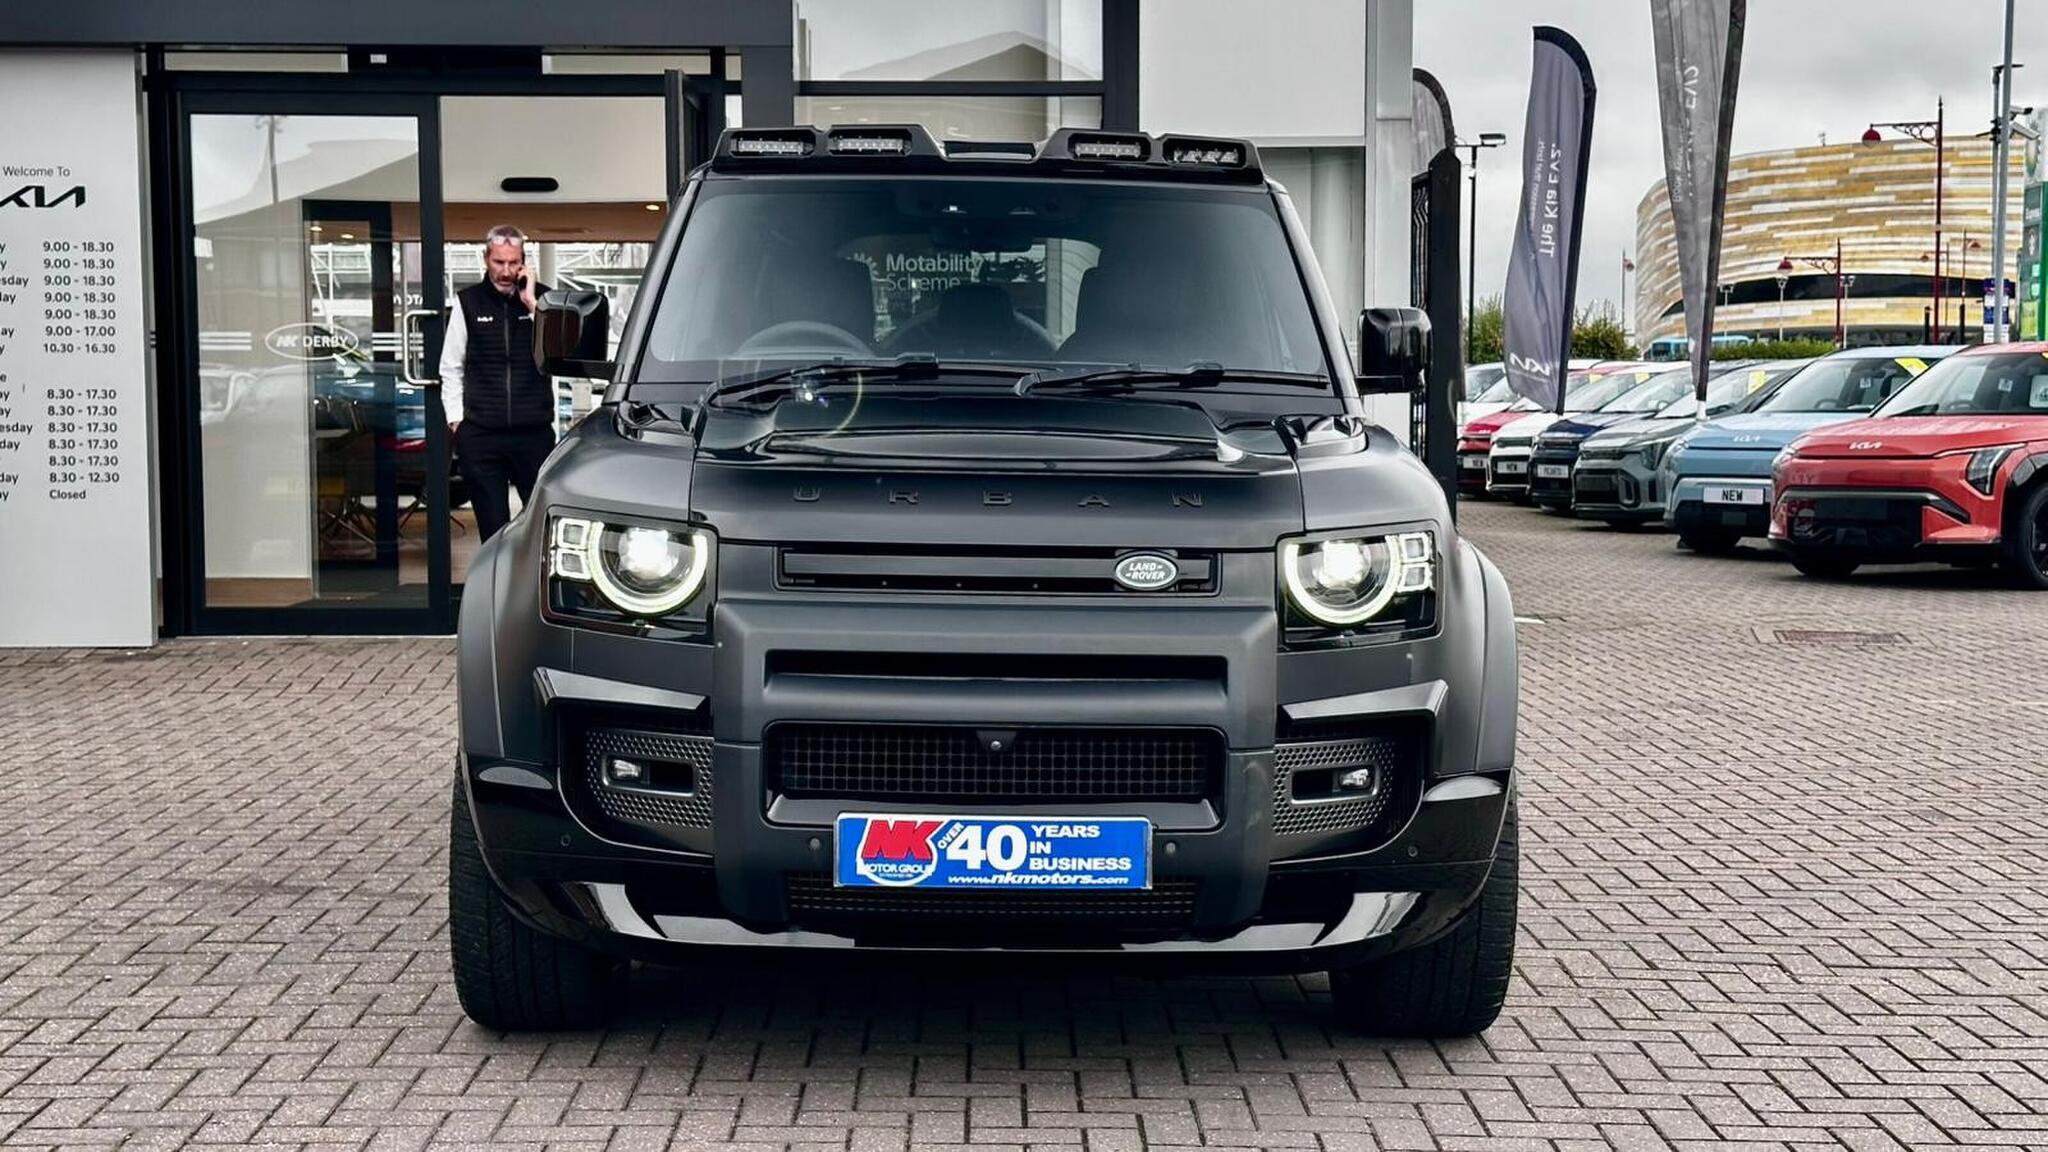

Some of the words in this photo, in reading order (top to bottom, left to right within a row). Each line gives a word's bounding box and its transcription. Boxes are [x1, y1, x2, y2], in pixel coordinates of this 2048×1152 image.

[3, 166, 54, 177] Welcome
[57, 166, 70, 177] To
[43, 241, 71, 253] 9.00
[82, 242, 115, 253] 18.30
[44, 258, 71, 270] 9.00
[83, 259, 115, 270] 18.30
[886, 253, 984, 276] Motability
[44, 275, 72, 287] 9.00
[83, 276, 116, 287] 18.30
[45, 292, 72, 303] 9.00
[84, 292, 116, 304] 18.30
[45, 309, 73, 320] 9.00
[84, 309, 117, 320] 18.30
[46, 326, 73, 337] 9.00
[84, 326, 116, 337] 17.00
[302, 336, 349, 348] DERBY
[44, 343, 75, 354] 10.30
[85, 344, 116, 354] 16.30
[47, 389, 75, 400] 8.30
[86, 389, 117, 400] 17.30
[48, 405, 75, 417] 8.30
[87, 406, 118, 417] 17.30
[48, 422, 76, 434] 8.30
[87, 422, 118, 434] 17.30
[49, 439, 76, 450] 8.30
[88, 439, 119, 450] 17.30
[49, 456, 77, 467] 8.30
[88, 456, 119, 467] 17.30
[49, 472, 77, 484] 8.30
[88, 472, 120, 484] 12.30
[49, 489, 87, 500] Closed
[793, 488, 1204, 507] URBAN
[1721, 488, 1744, 502] NEW
[937, 822, 965, 850] OVER
[1031, 825, 1101, 838] YEARS
[861, 819, 943, 859] NK
[946, 824, 1027, 871] 40
[1029, 842, 1051, 854] IN
[1029, 858, 1132, 871] BUSINESS
[948, 872, 1129, 885] www.nkmotors.com
